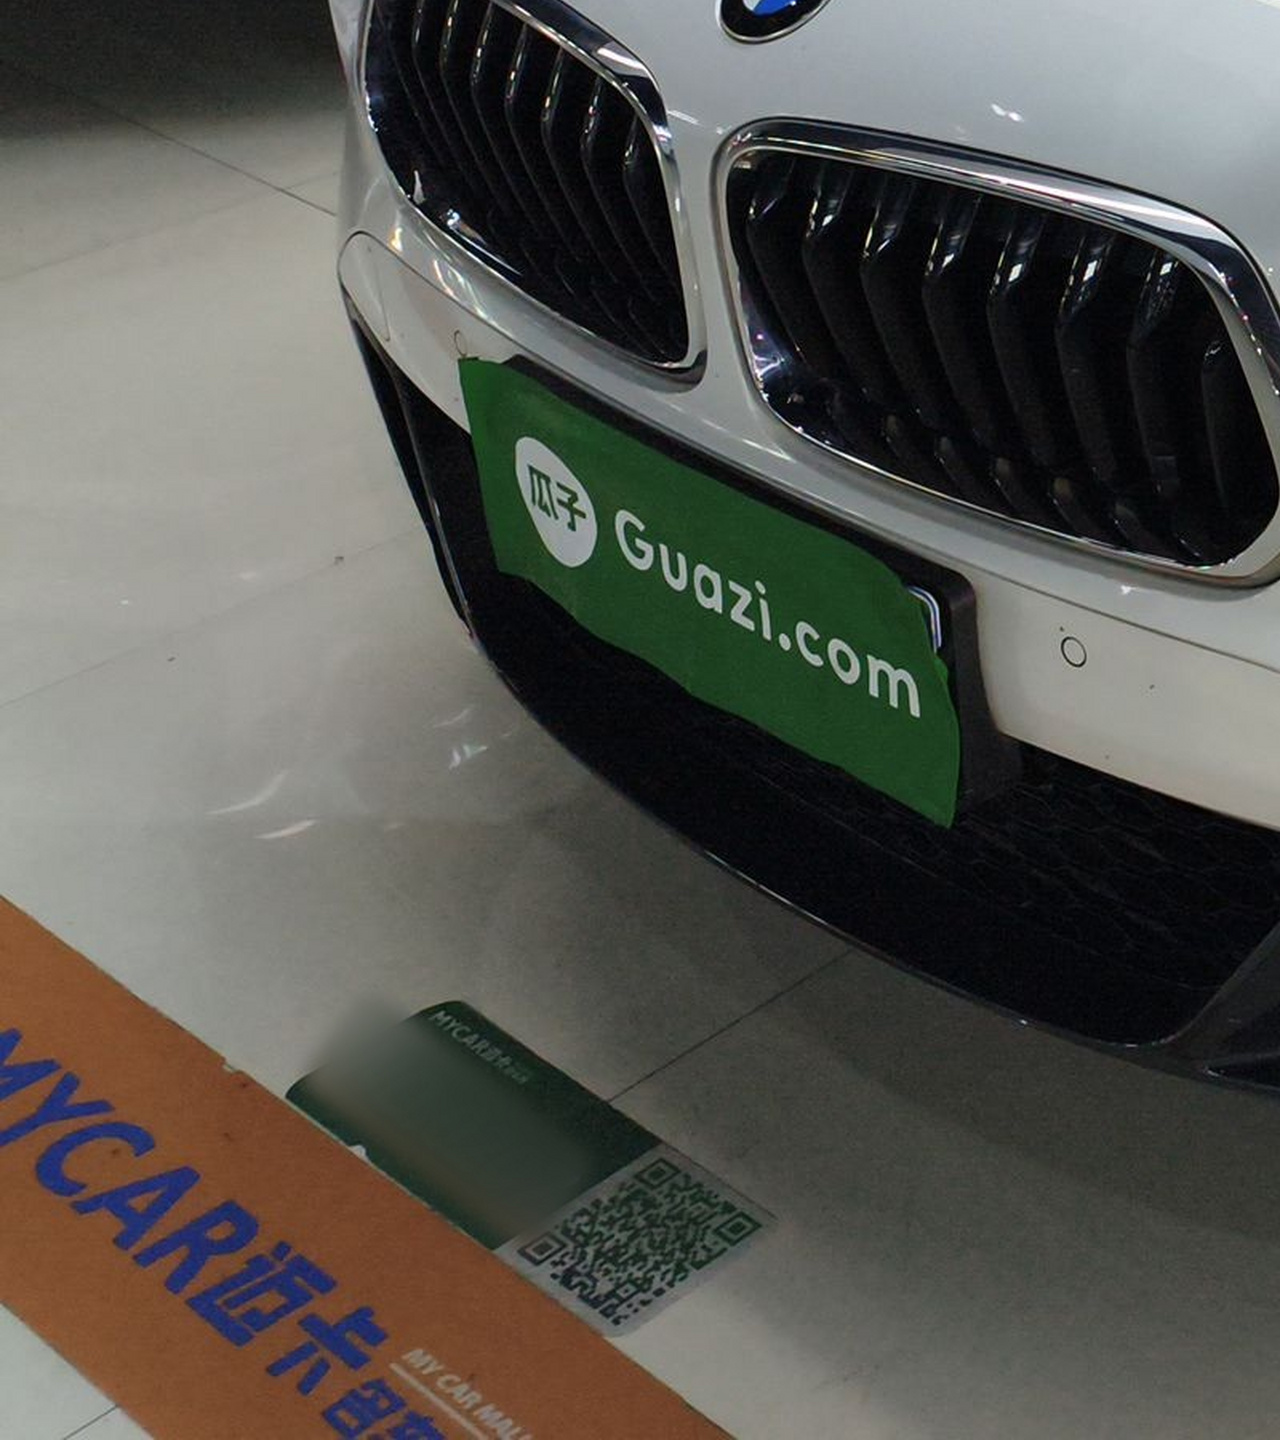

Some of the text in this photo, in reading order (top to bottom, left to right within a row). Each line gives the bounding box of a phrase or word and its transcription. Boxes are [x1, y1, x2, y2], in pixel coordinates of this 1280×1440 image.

[527, 464, 586, 532] 瓜子
[614, 509, 921, 718] Guazi.com
[402, 1348, 532, 1440] MY CAR MAL
